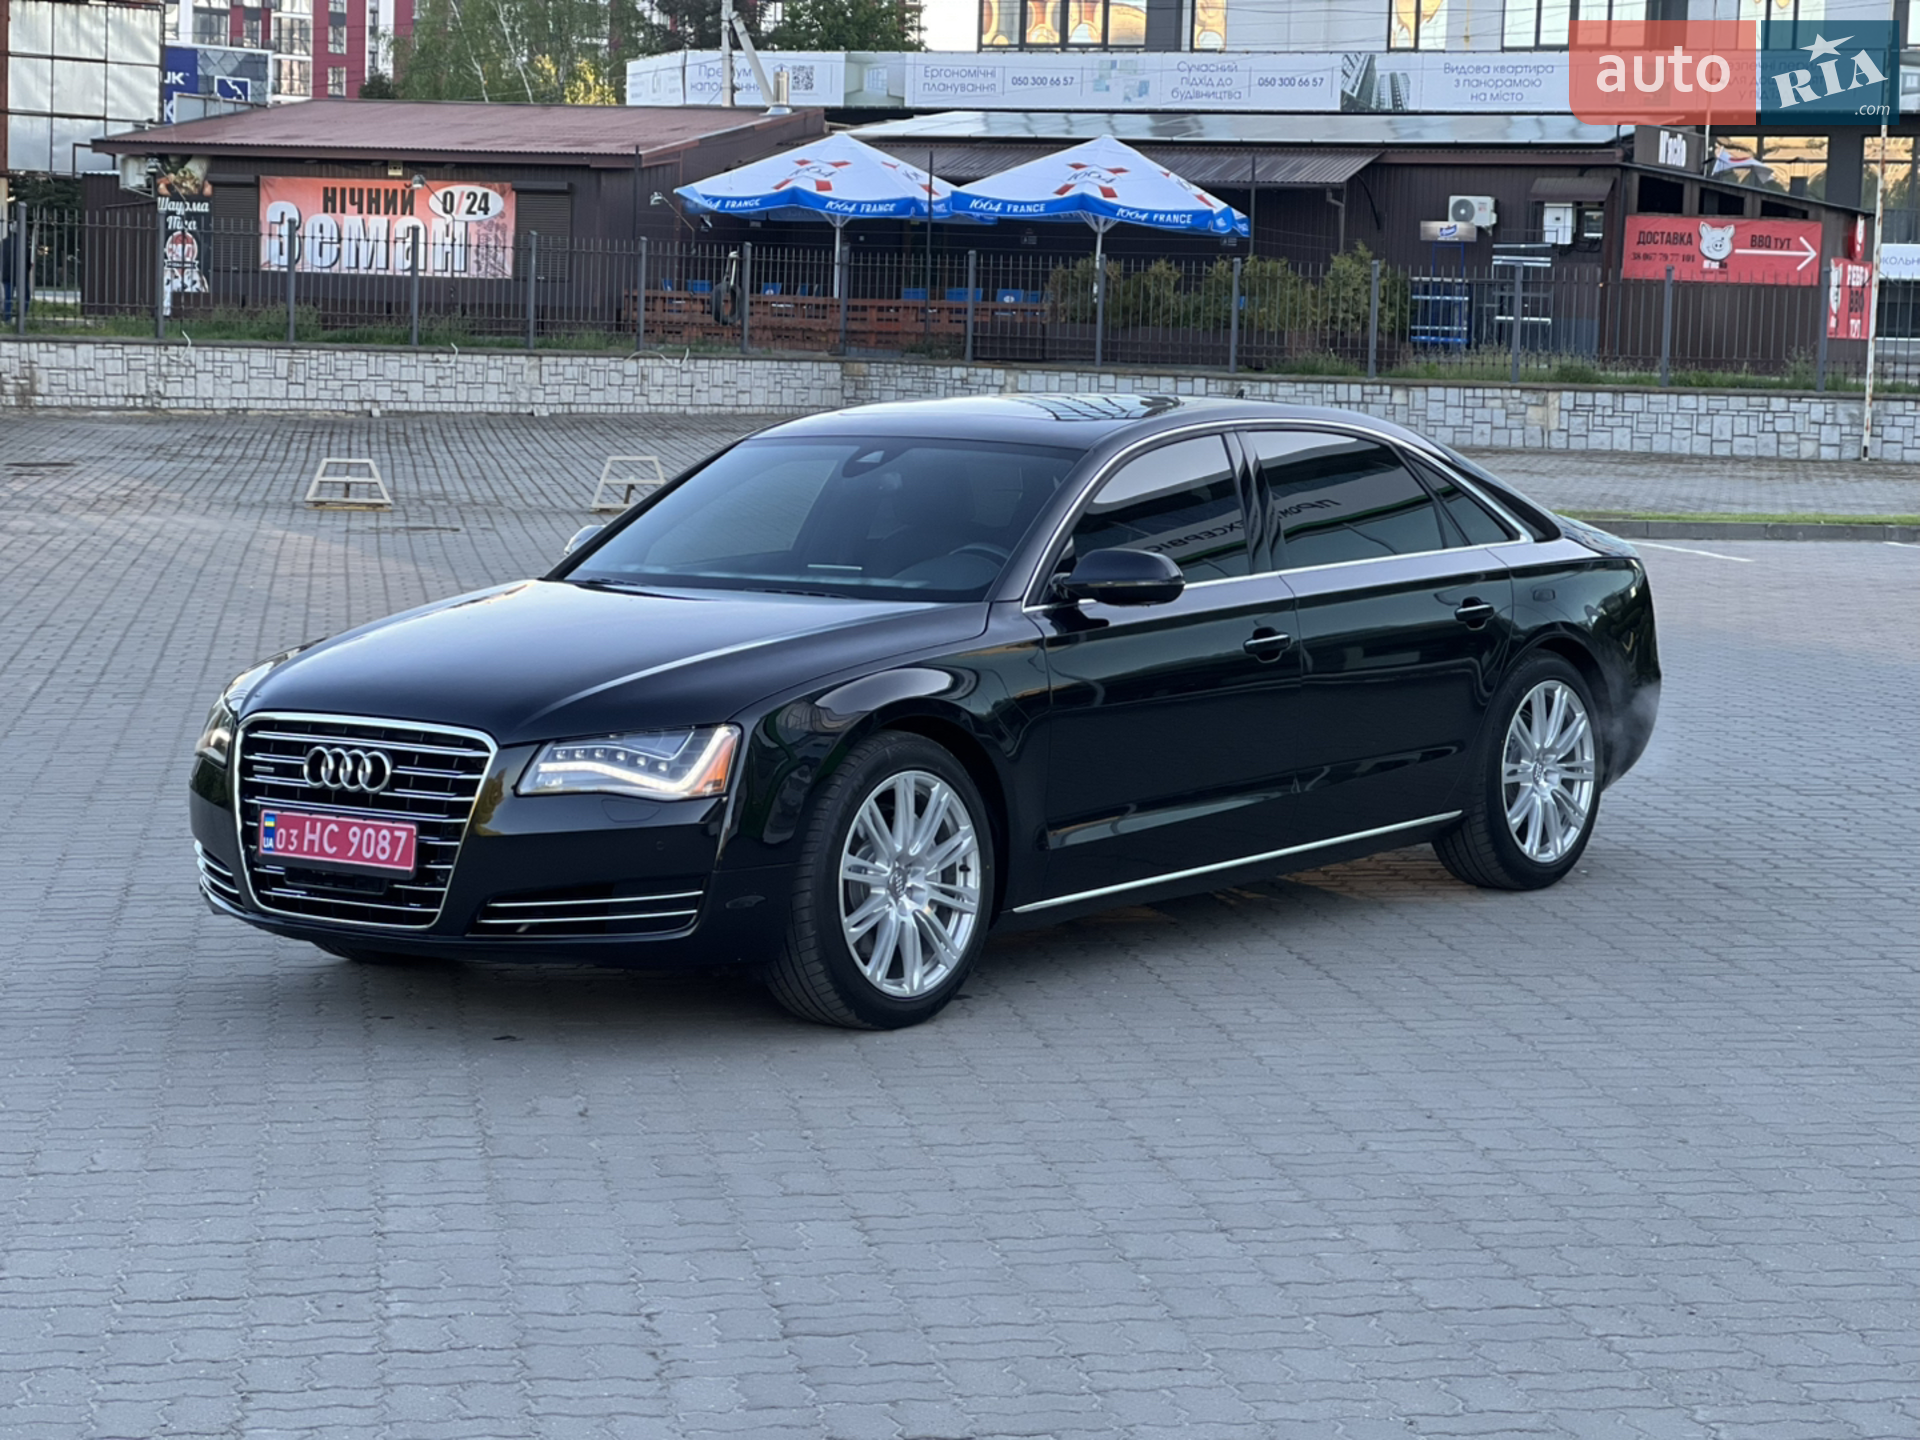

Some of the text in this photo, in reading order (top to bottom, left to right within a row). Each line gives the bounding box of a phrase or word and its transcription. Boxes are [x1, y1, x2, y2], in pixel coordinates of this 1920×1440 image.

[923, 66, 997, 79] Ергономічні
[1177, 61, 1238, 73] Сучасний
[1443, 62, 1554, 76] Видова квартира
[922, 81, 997, 92] планування
[1011, 75, 1075, 86] 050 300 66 57
[1180, 76, 1233, 87] підхід до
[1258, 76, 1324, 87] 050 300 66 57
[1454, 77, 1542, 88] з панорамою
[1171, 88, 1242, 100] будівництва
[1471, 91, 1523, 101] на місто
[322, 183, 490, 215] НІЧНИЙ 0/24
[725, 198, 761, 210] FRANCE
[860, 203, 896, 213] FRANCE
[1007, 203, 1045, 213] FRANCE
[1153, 212, 1193, 224] FRANCE
[267, 201, 469, 273] Земан
[1636, 230, 1693, 246] ДОСТАВКА
[1750, 234, 1771, 249] BBQ
[263, 837, 274, 849] UA
[276, 820, 407, 862] 03 HC 9087
